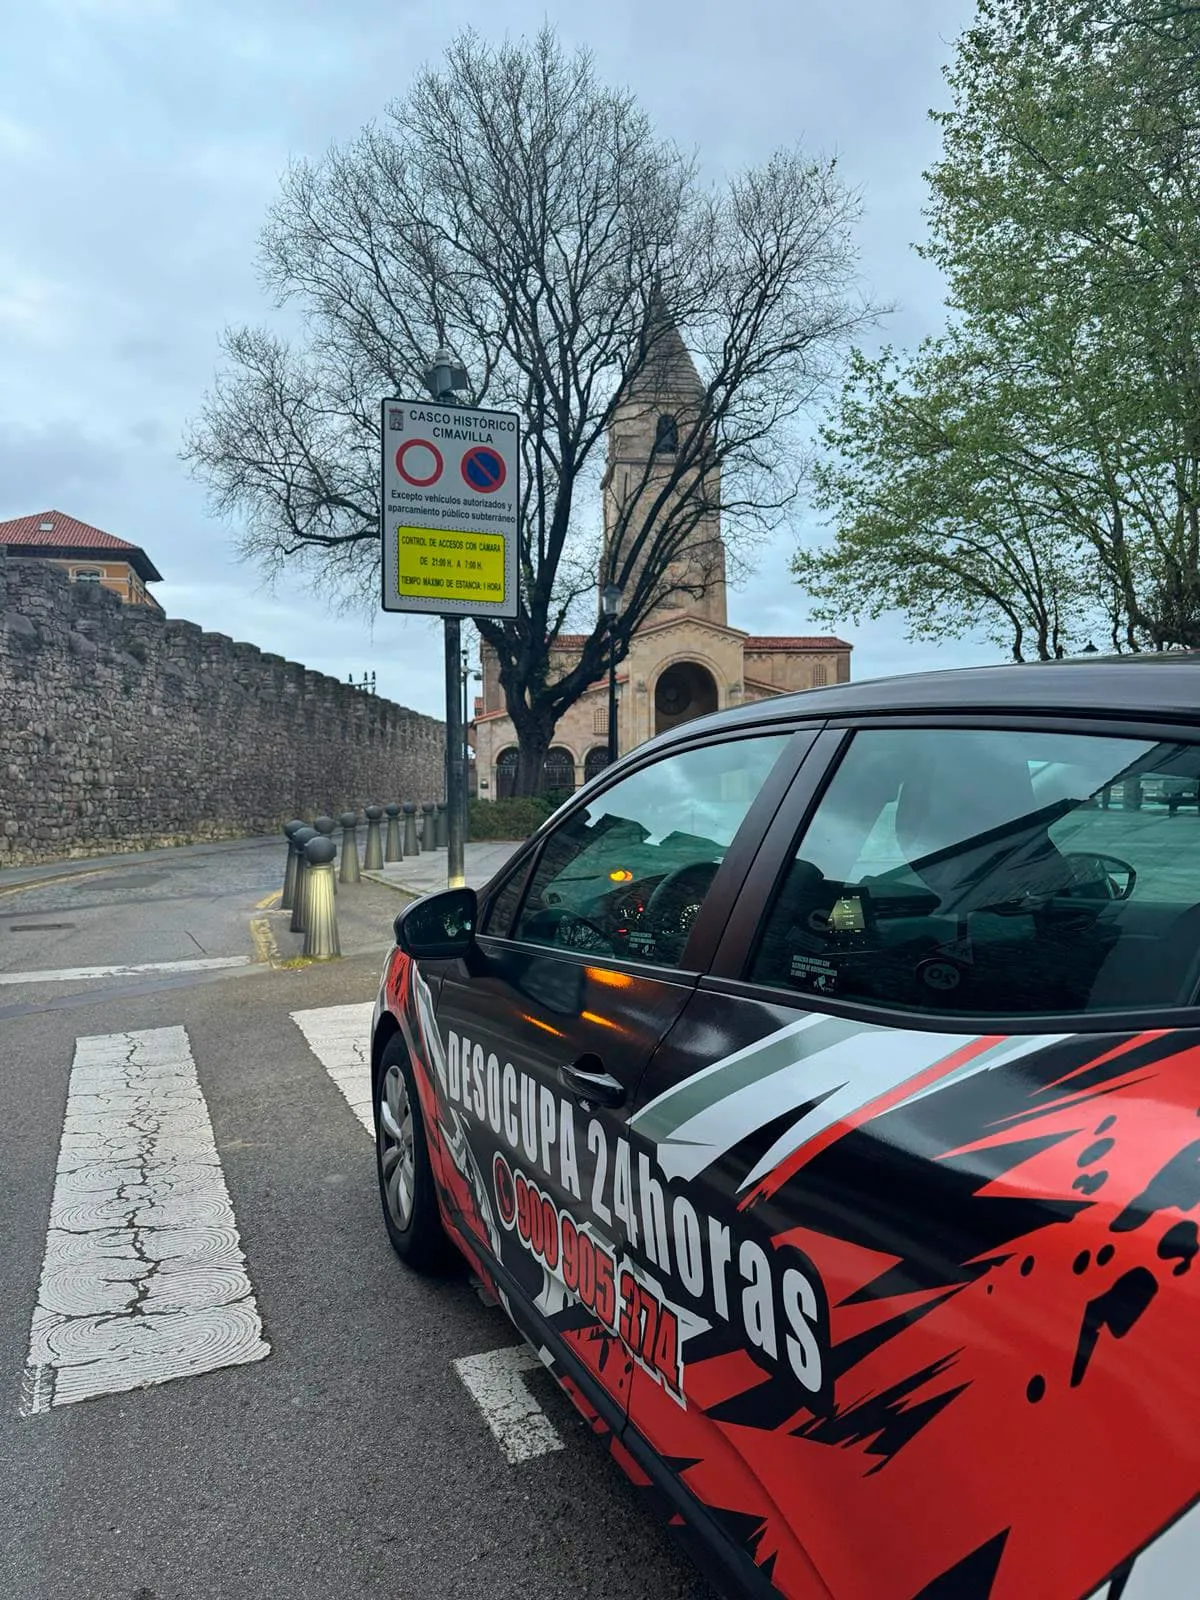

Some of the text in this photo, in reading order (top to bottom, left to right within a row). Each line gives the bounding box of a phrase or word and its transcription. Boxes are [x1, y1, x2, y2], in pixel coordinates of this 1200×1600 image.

[409, 410, 515, 432] CASCO HISTÓRICO
[432, 427, 494, 443] CIMAVILLA
[391, 489, 423, 502] Excepto
[462, 498, 506, 509] autorizados
[507, 503, 513, 512] y
[388, 504, 440, 516] aparcamiento
[441, 507, 470, 519] público
[401, 535, 427, 546] CONTROL
[429, 537, 437, 547] DE
[439, 539, 464, 550] ACCESOS
[465, 541, 477, 551] CON
[419, 556, 428, 566] DE
[401, 575, 421, 586] TIEMPO
[446, 578, 454, 588] DE
[486, 582, 502, 592] HORA
[447, 1030, 823, 1393] DESOCUPA 24horas
[516, 1176, 682, 1392] 900 905 374
